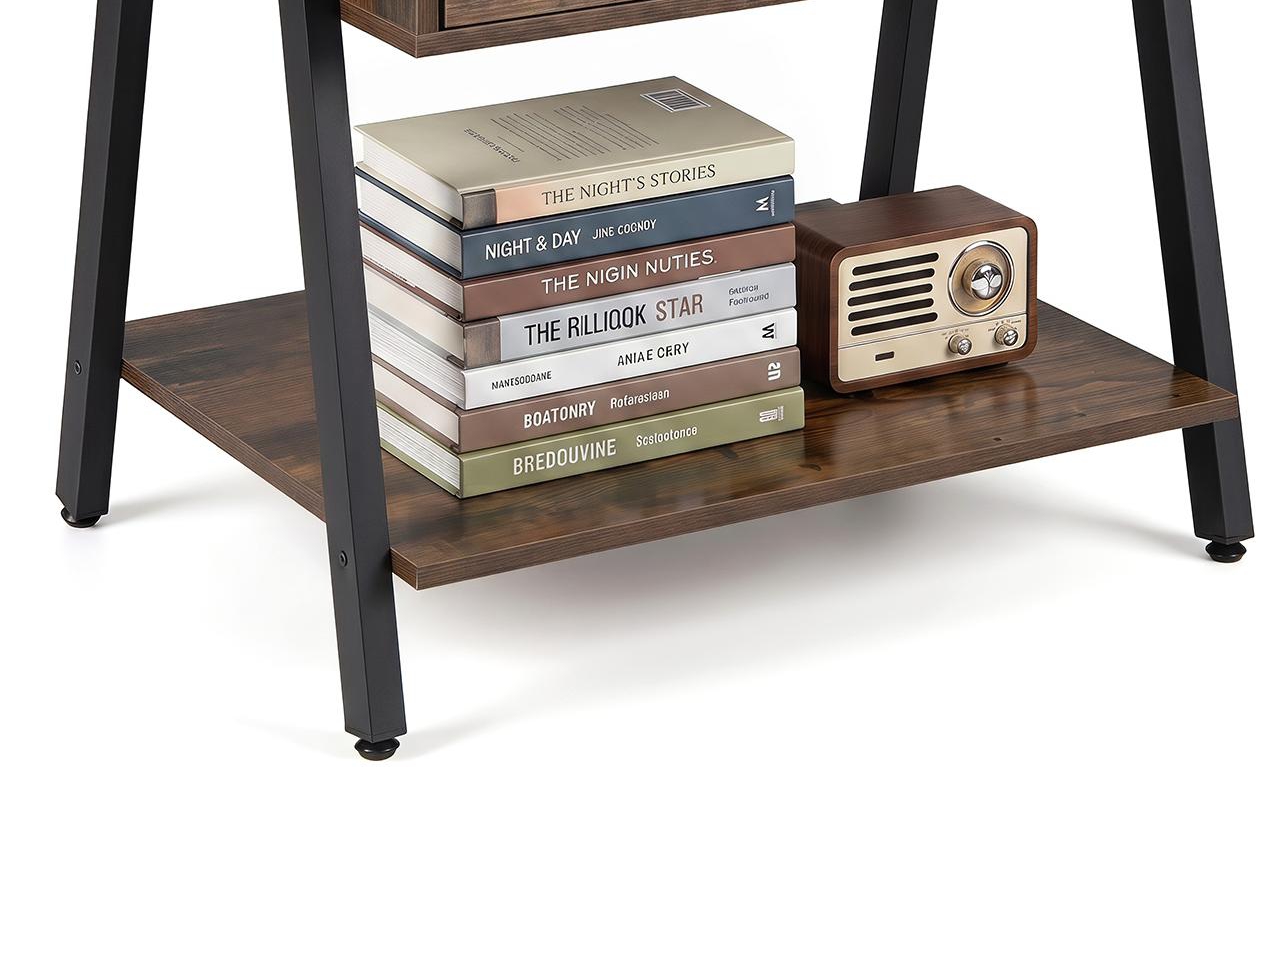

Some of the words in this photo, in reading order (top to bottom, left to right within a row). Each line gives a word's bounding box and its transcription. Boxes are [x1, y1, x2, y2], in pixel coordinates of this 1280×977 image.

[542, 187, 575, 205] THE
[580, 175, 645, 200] NIGHT'S
[650, 163, 716, 188] STORIES
[485, 237, 532, 260] NIGHT
[535, 235, 548, 252] &
[552, 228, 582, 249] DAY
[541, 273, 580, 294] THE
[586, 263, 638, 287] NIGIN
[524, 319, 561, 346] THE
[655, 293, 703, 322] STAR
[523, 400, 597, 429] BOATONRY
[513, 438, 617, 476] BREDOUVINE
